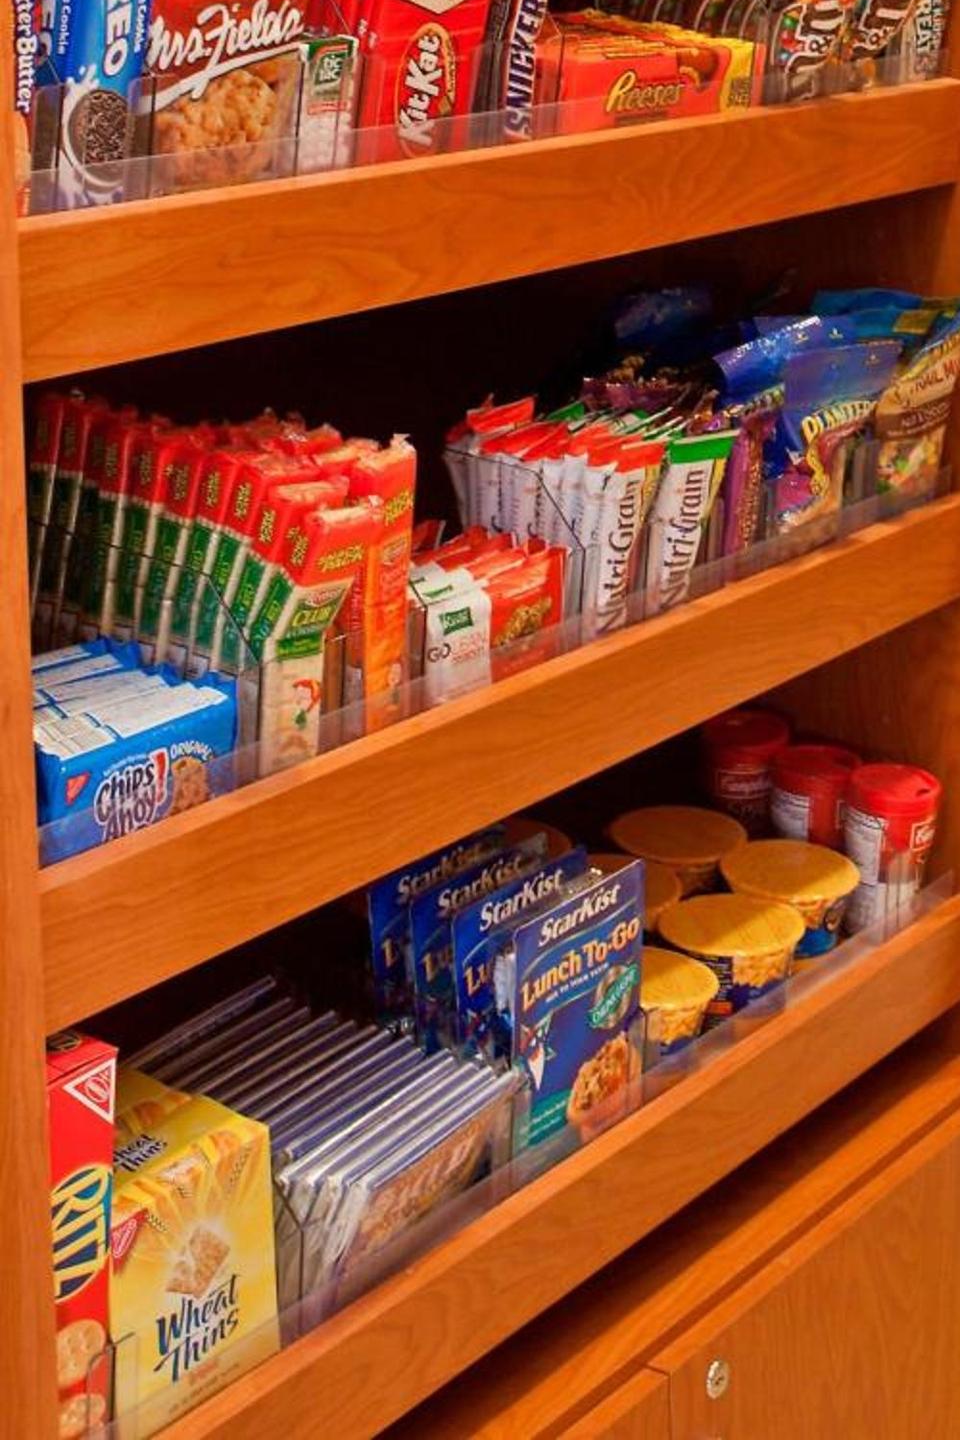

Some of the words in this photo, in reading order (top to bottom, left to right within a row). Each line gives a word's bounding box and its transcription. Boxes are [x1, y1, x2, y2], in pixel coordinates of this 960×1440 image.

[95, 762, 156, 823] Chips
[479, 868, 564, 932] StarKist
[538, 884, 621, 947] StarKist
[520, 949, 583, 1011] Lunch
[153, 1308, 239, 1384] Thins
[156, 1273, 238, 1357] Wheat
